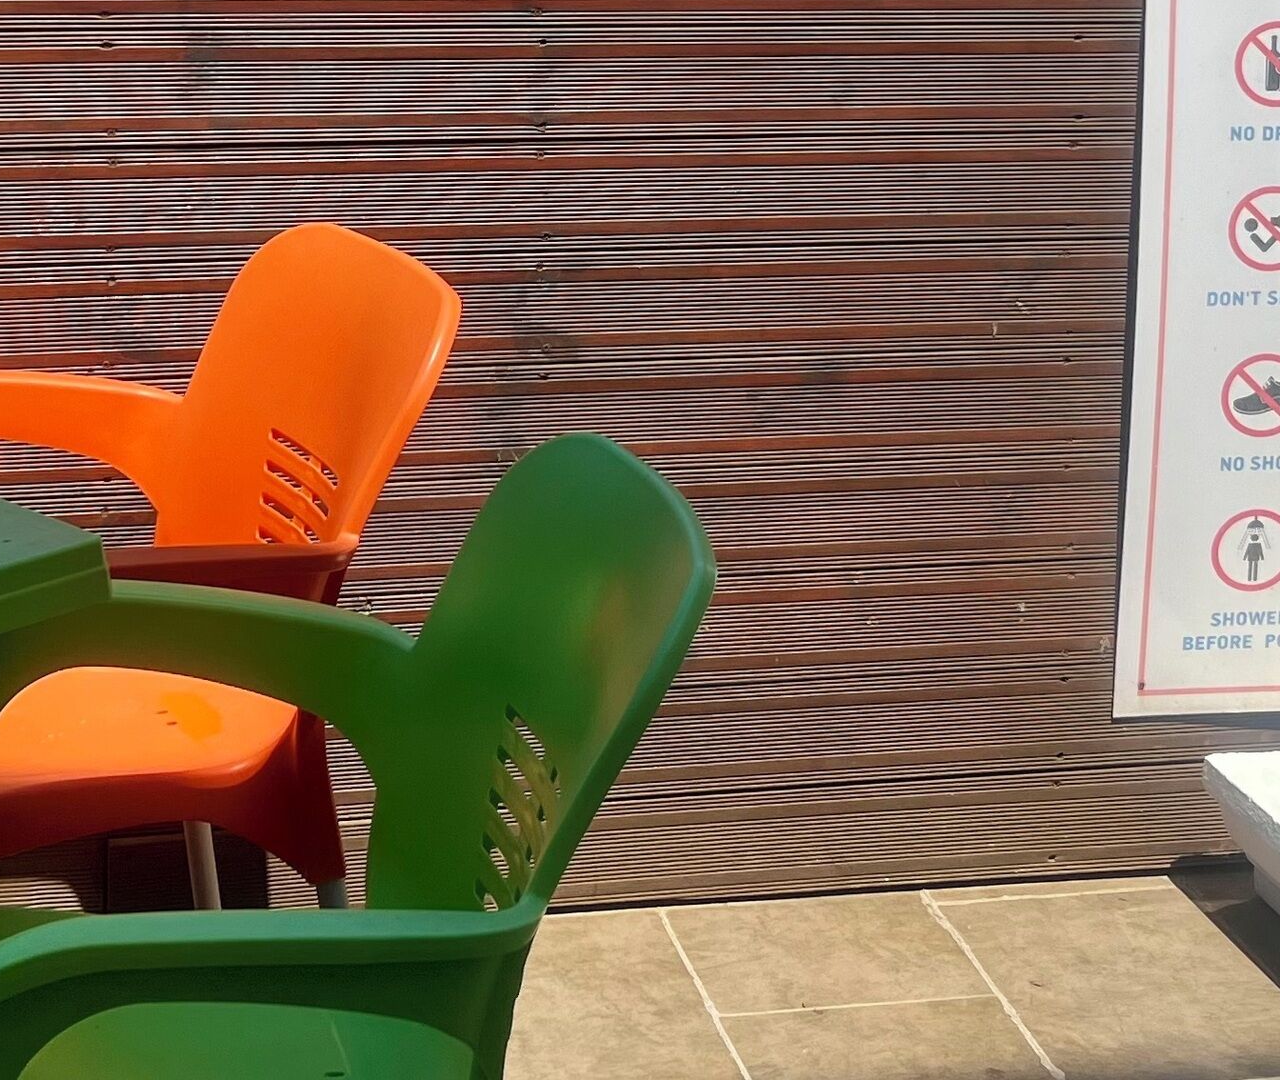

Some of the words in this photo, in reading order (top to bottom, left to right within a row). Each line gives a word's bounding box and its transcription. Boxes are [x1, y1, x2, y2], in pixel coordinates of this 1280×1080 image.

[1230, 125, 1256, 142] NO
[1206, 290, 1262, 307] DON'T
[1220, 456, 1245, 472] NO
[1182, 634, 1253, 651] BEFORE
